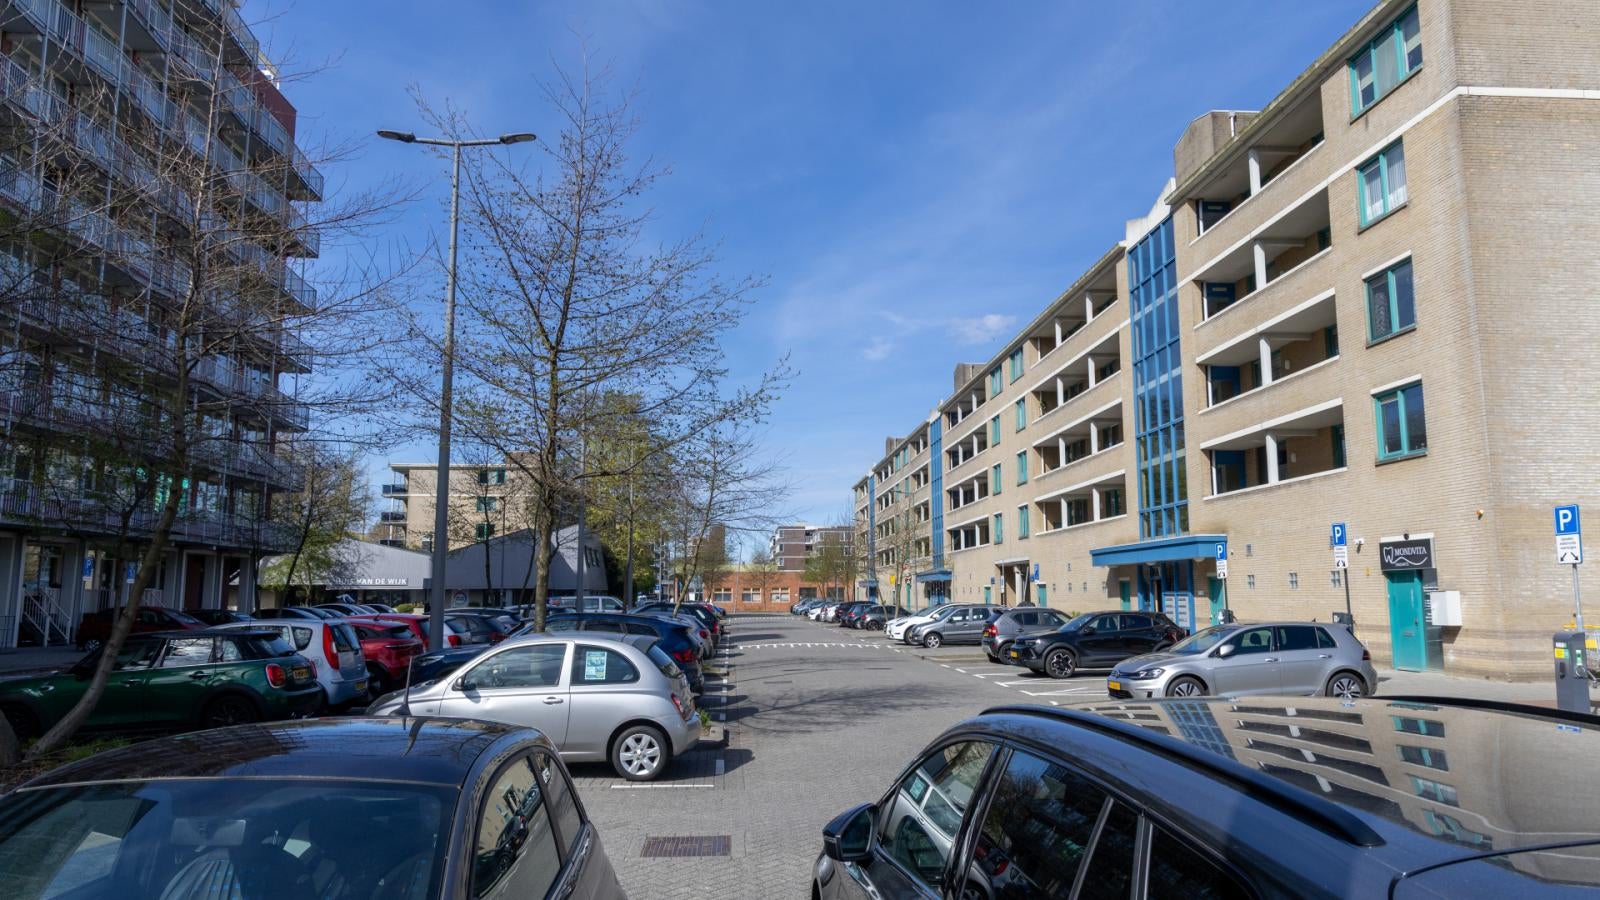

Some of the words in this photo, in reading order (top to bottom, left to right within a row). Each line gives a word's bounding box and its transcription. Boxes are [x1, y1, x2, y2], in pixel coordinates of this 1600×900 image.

[1559, 509, 1572, 531] P
[1334, 526, 1342, 543] P
[1217, 544, 1223, 559] P
